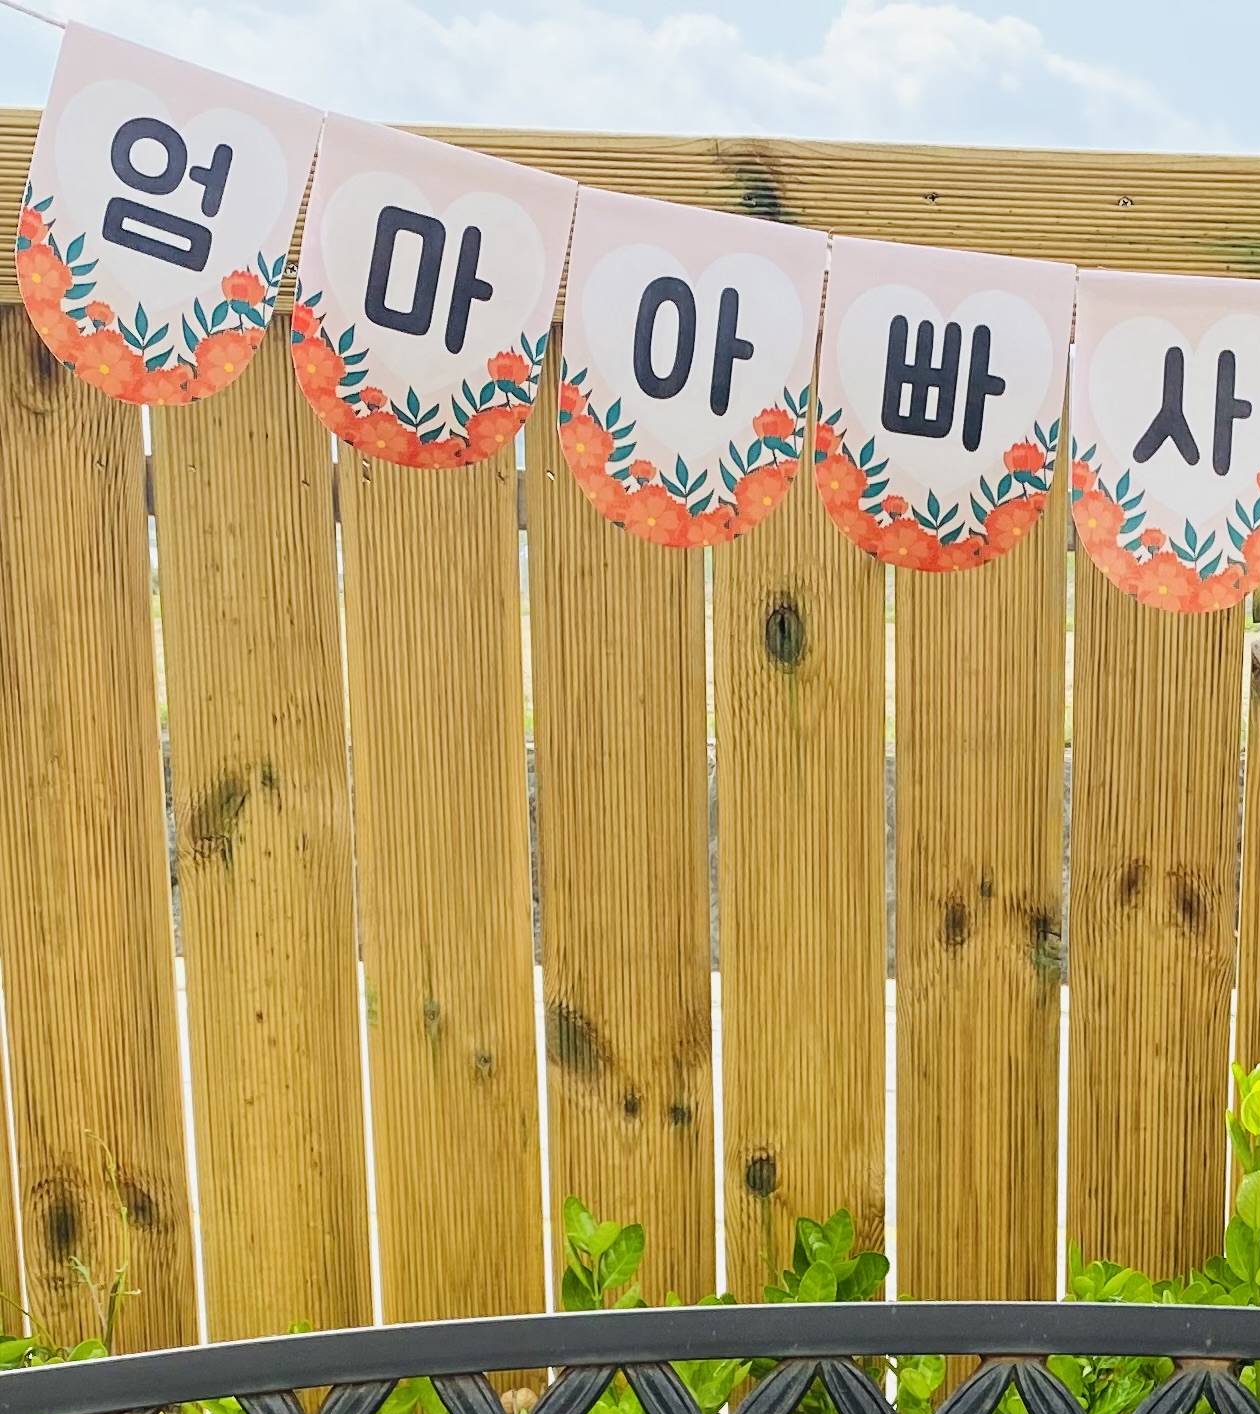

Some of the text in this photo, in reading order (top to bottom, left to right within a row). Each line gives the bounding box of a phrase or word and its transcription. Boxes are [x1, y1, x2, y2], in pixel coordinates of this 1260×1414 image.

[100, 116, 234, 274] 엄
[363, 204, 495, 356] 마
[632, 275, 756, 418] 아
[879, 313, 1007, 454] 빠
[1134, 345, 1254, 478] 사
